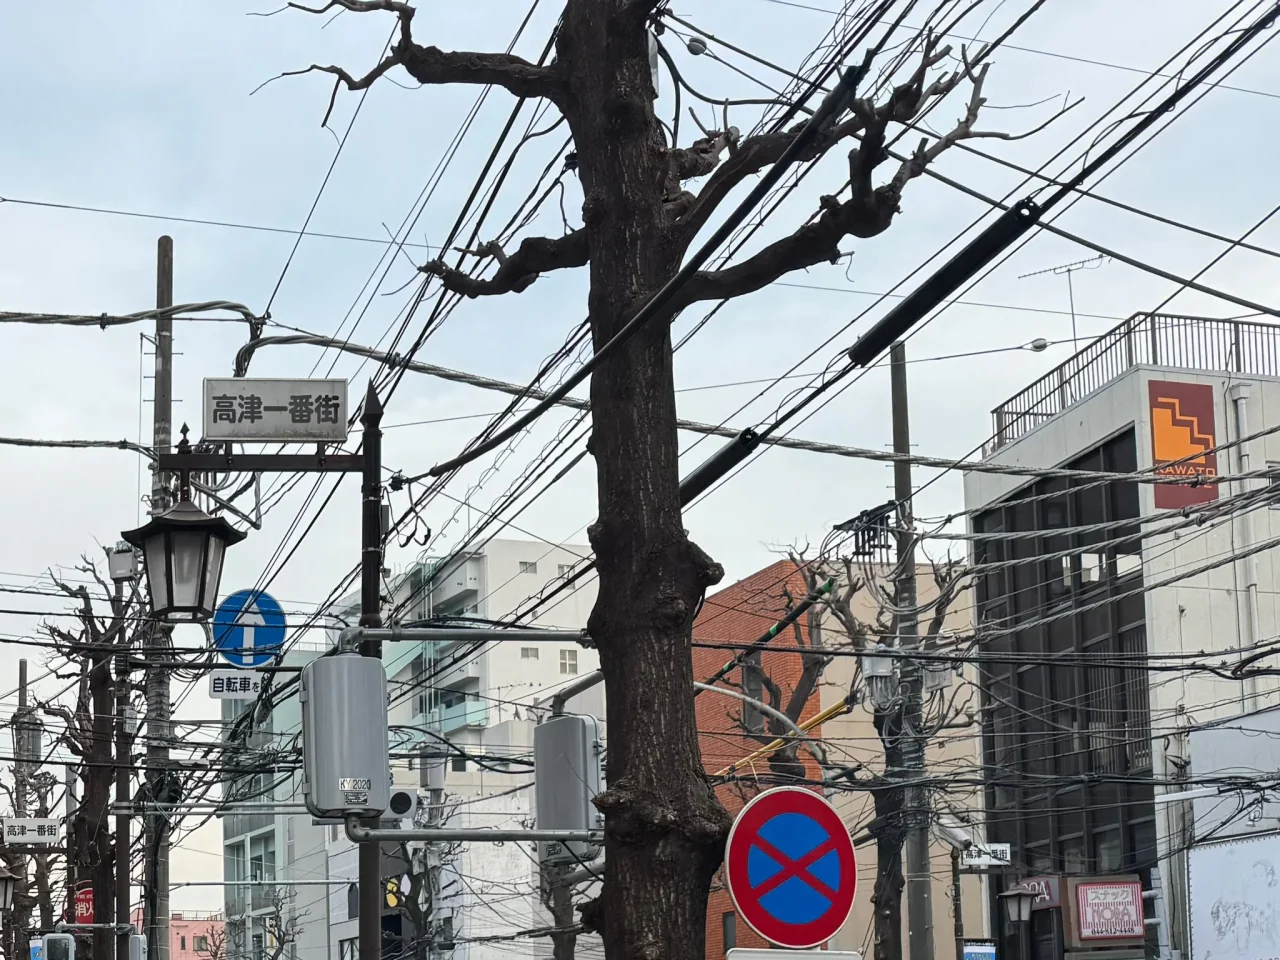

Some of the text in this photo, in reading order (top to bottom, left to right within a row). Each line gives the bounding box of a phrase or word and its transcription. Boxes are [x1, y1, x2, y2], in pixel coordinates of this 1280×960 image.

[211, 393, 340, 425] 高津一番街
[352, 779, 372, 791] 2020
[6, 824, 57, 837] 高津一番街
[1090, 889, 1130, 901] スナック
[1091, 906, 1131, 921] NORA
